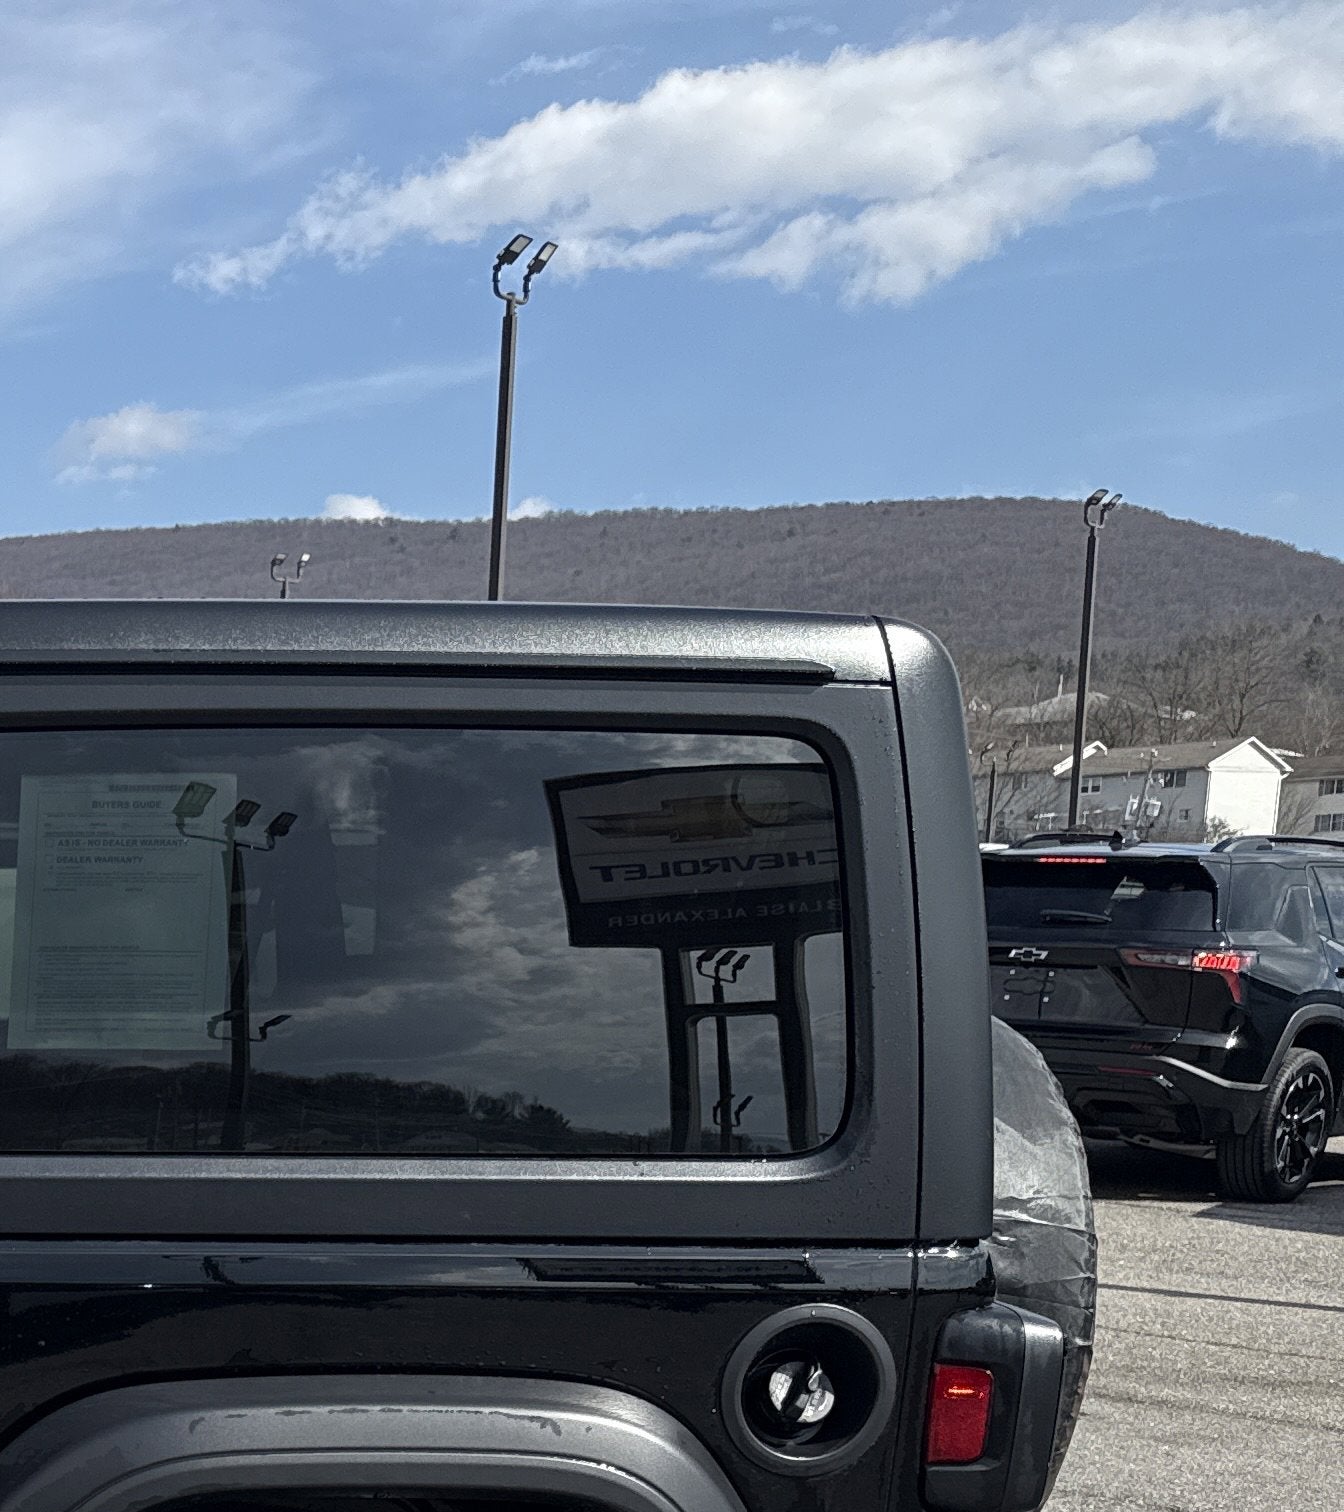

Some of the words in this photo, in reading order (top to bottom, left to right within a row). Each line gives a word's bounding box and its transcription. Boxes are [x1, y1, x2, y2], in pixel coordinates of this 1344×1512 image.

[91, 800, 130, 809] BUYERS
[132, 800, 162, 809] GUIDE
[102, 839, 139, 847] DEALER
[139, 839, 190, 847] WARRANTY
[56, 856, 92, 864] DEALER
[94, 856, 144, 864] WARRANTY
